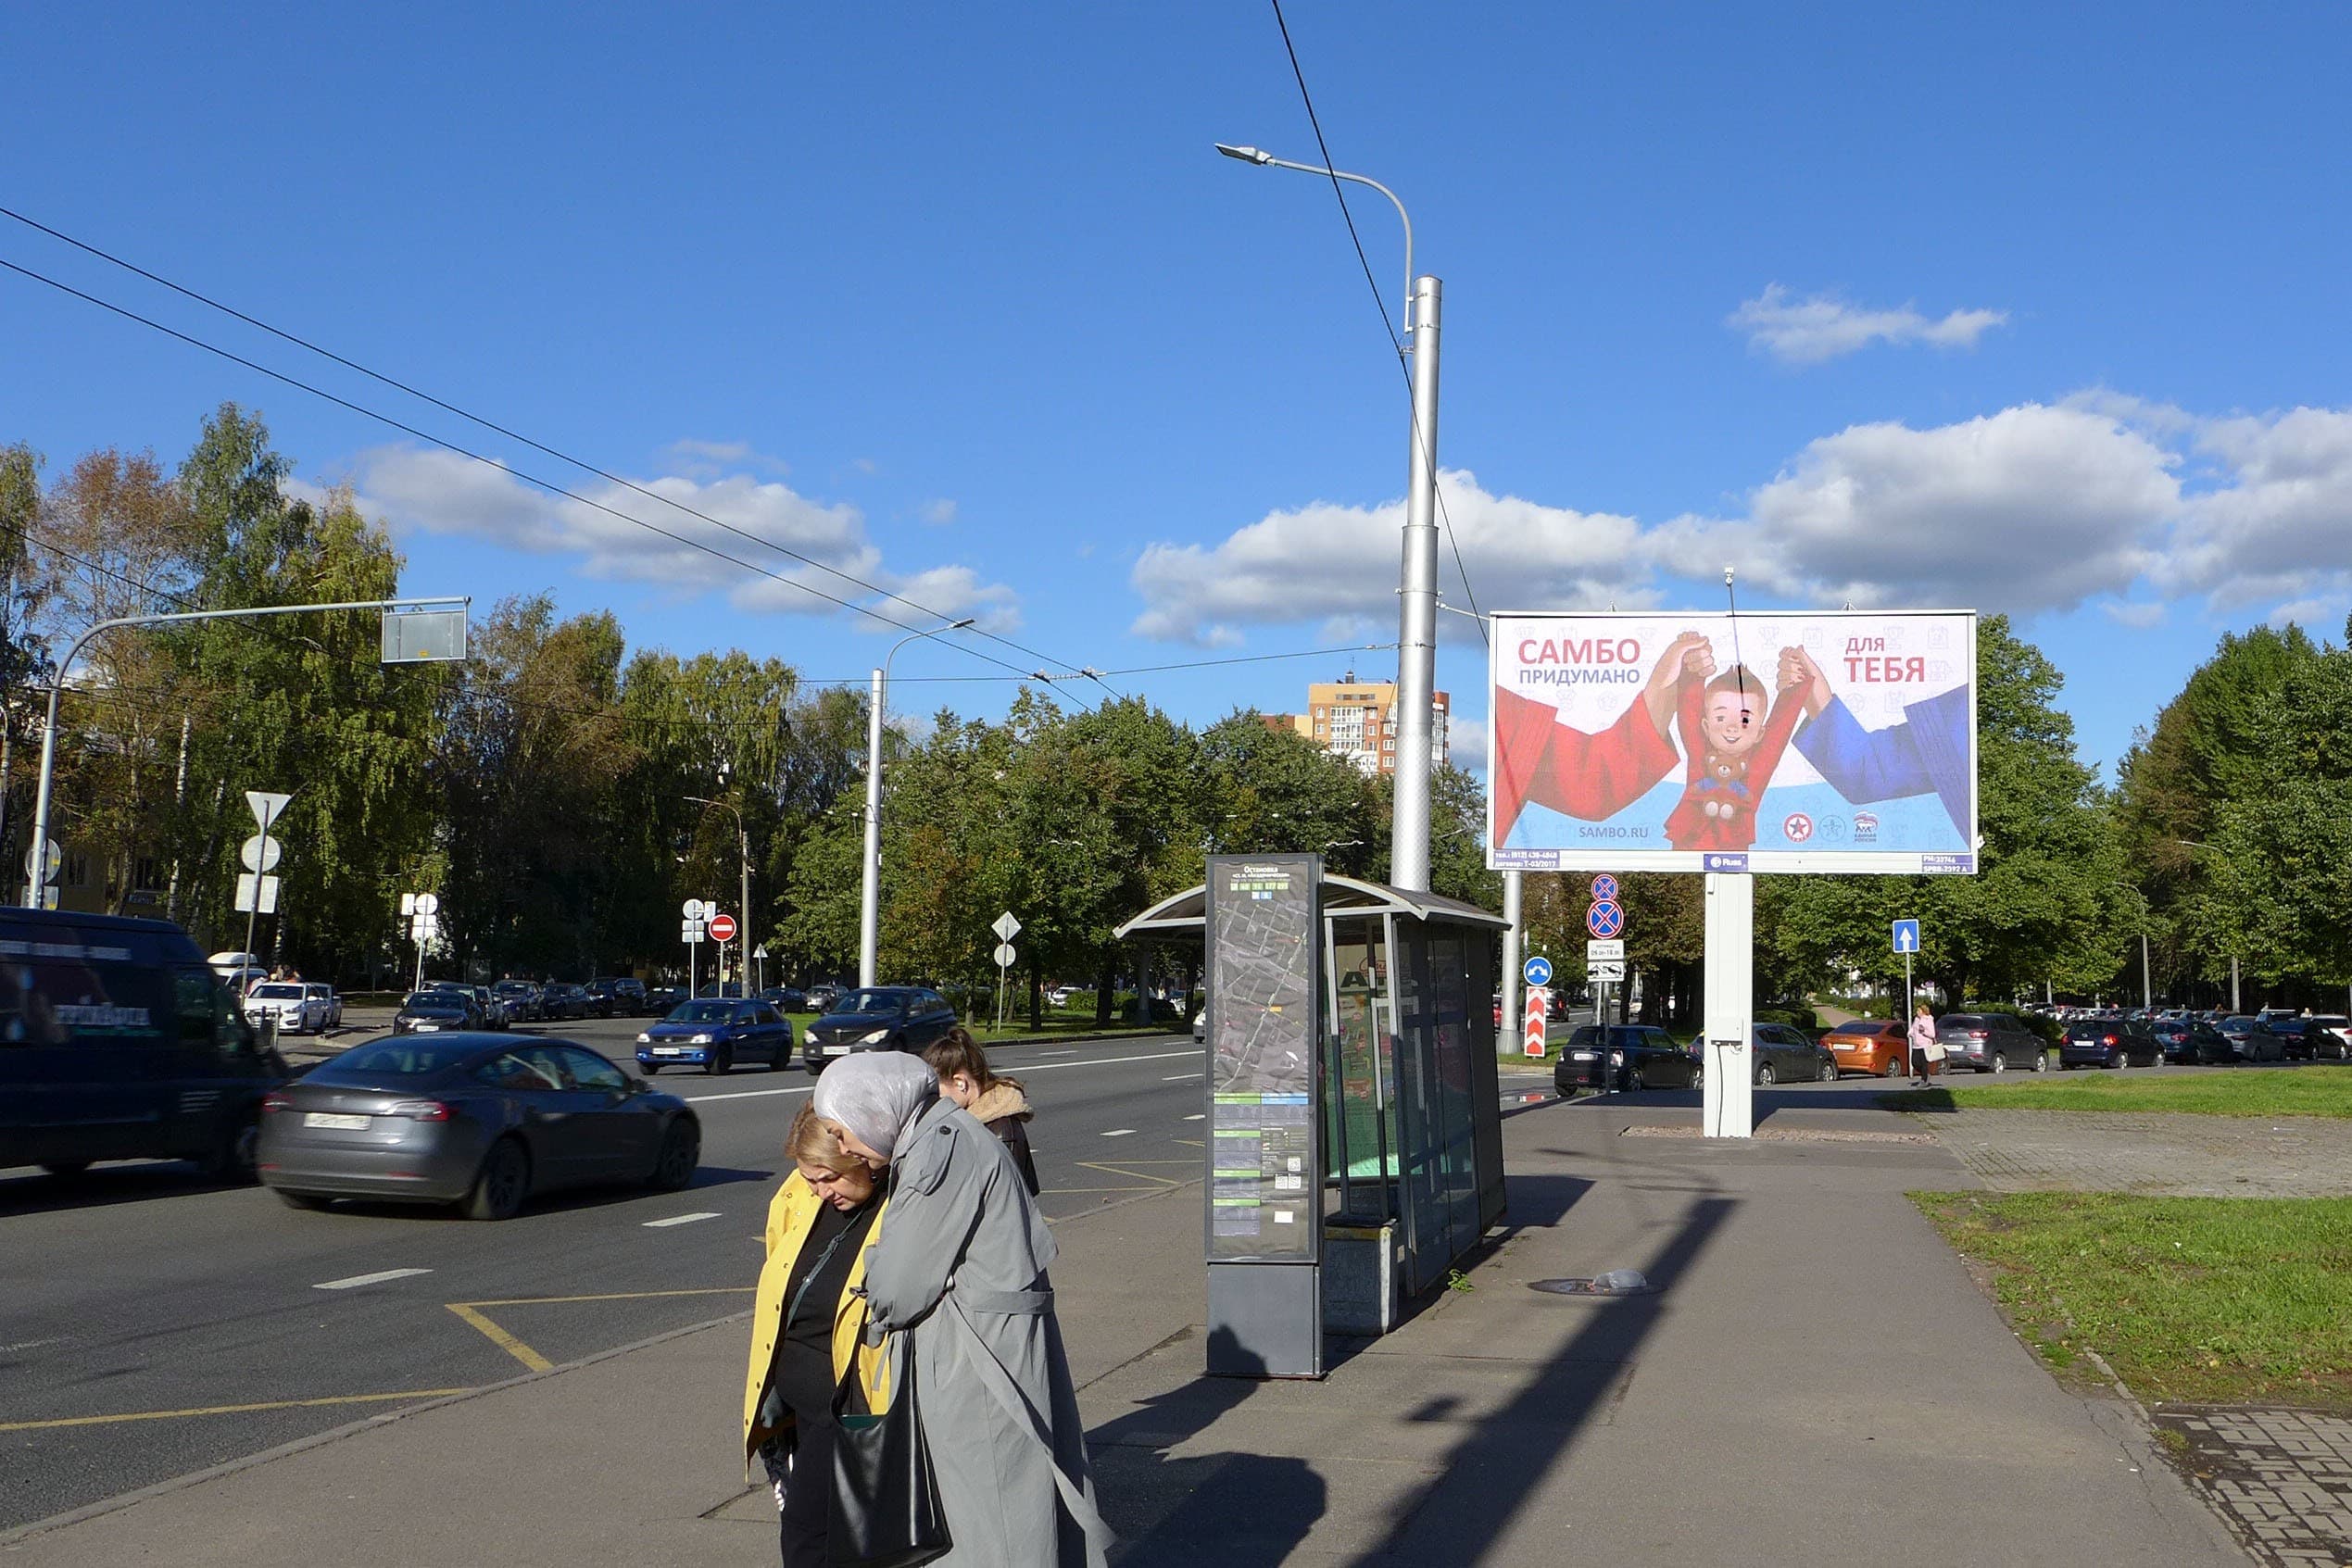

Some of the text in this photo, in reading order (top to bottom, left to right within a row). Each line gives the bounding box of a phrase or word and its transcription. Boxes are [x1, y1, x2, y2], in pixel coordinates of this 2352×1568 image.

[1518, 639, 1641, 664] САМБО
[1845, 637, 1885, 655] ДЛЯ
[1519, 669, 1641, 686] ПРИДУМАНО
[1843, 657, 1925, 683] ТЕБЯ
[1578, 826, 1649, 838] SAMBO.RU
